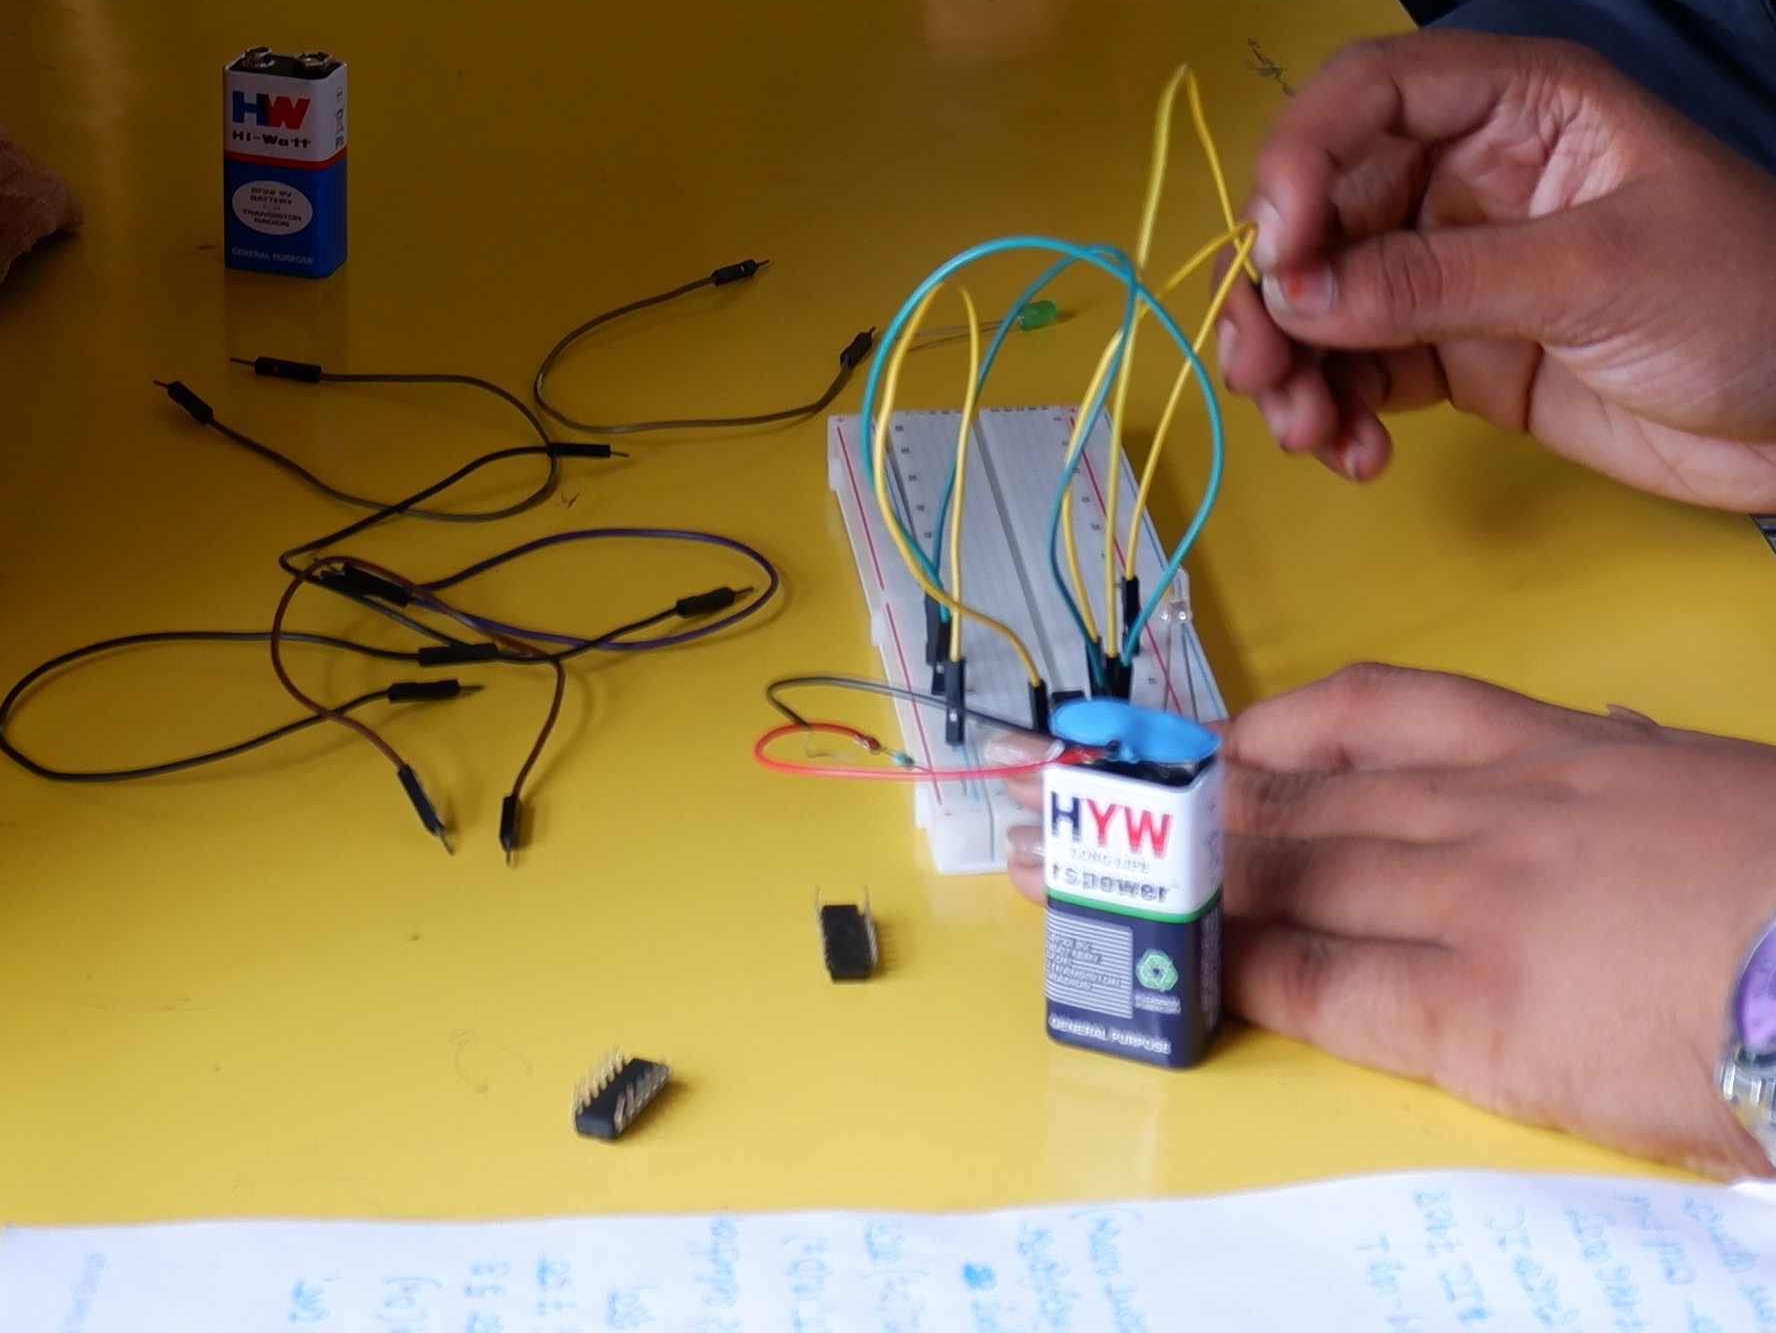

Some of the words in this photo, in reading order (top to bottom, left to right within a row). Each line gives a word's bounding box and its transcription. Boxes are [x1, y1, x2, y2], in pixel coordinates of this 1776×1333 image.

[232, 90, 311, 130] HW
[250, 195, 293, 205] BATTERY
[242, 208, 302, 222] TRANSISTOR
[232, 247, 270, 261] GENERAL
[272, 252, 314, 266] PURPOSE
[1048, 1013, 1108, 1042] GENERAL
[1109, 1027, 1172, 1055] PURPOSE
